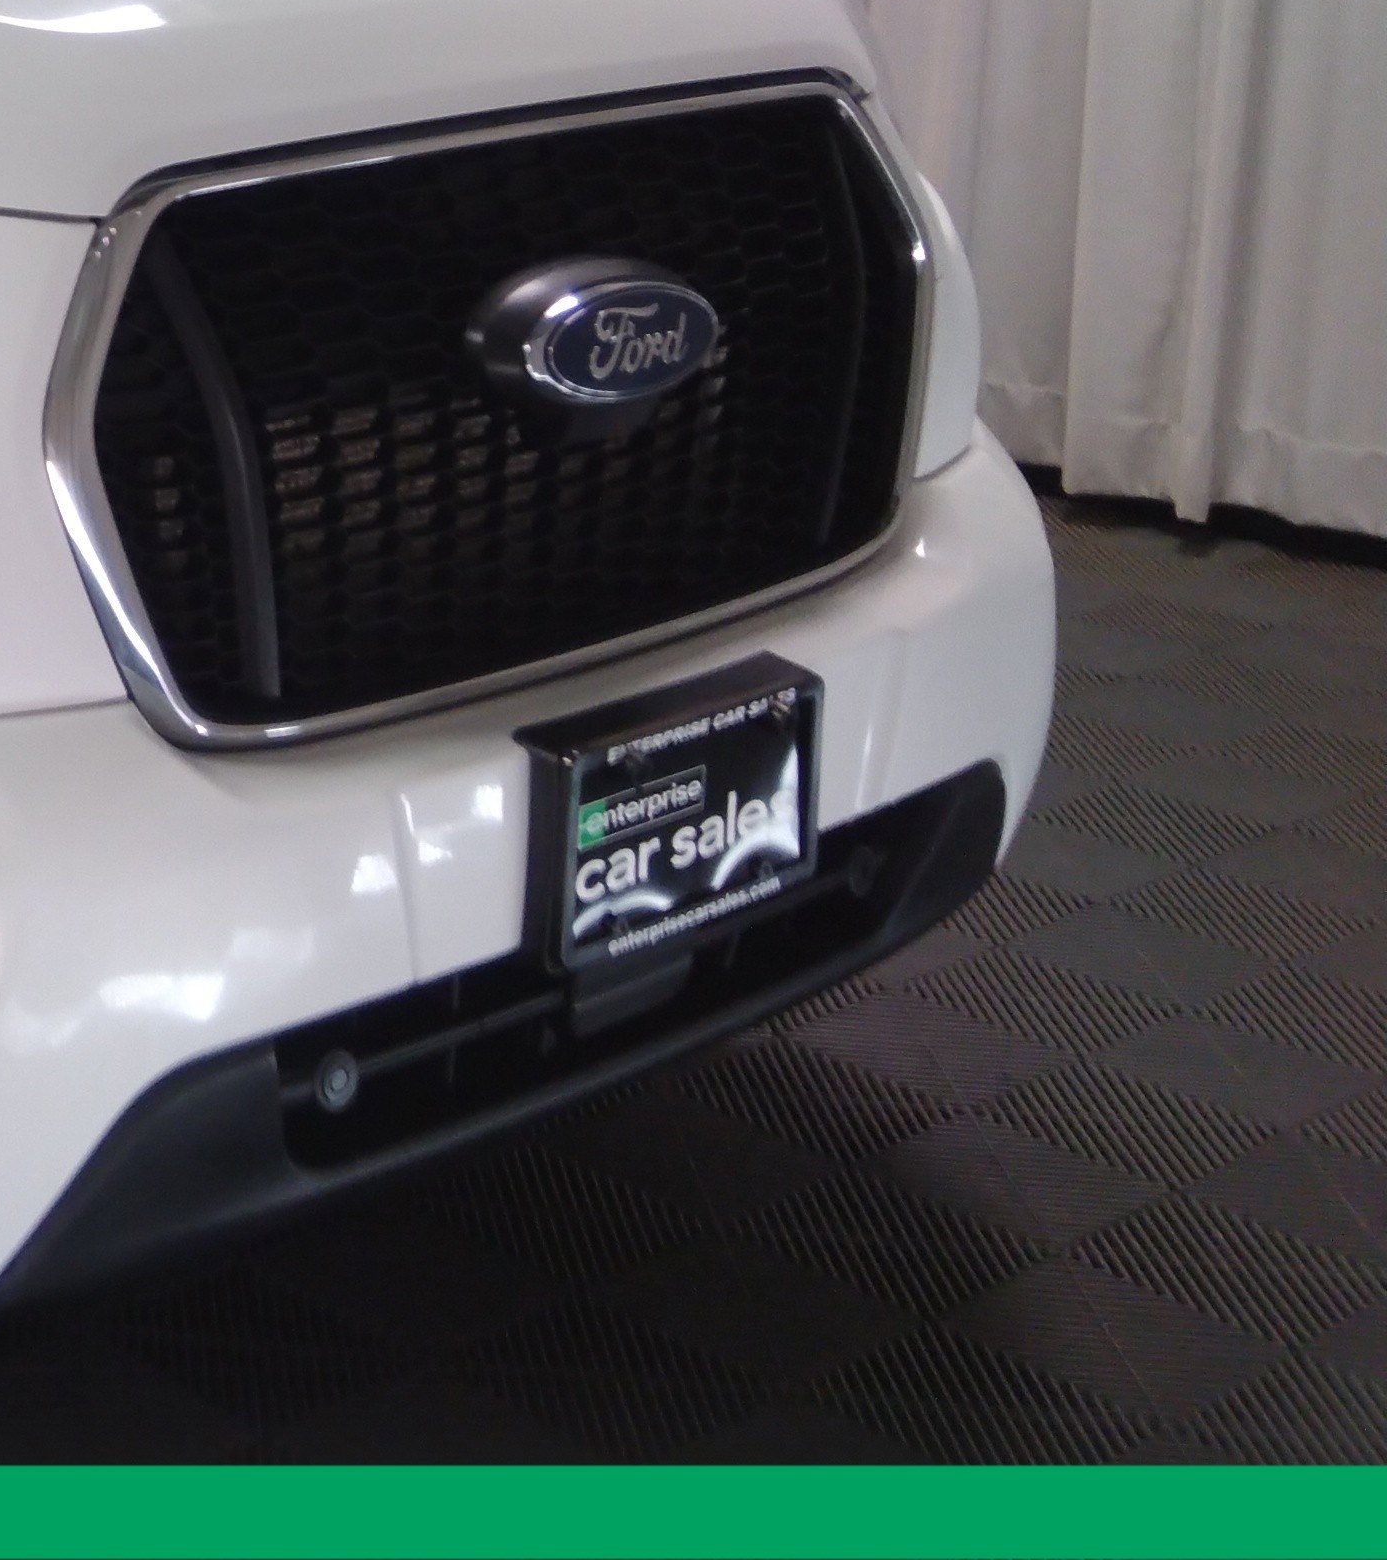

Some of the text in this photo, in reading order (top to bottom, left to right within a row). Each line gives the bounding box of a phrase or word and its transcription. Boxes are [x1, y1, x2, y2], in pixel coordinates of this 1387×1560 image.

[589, 302, 689, 380] Ford
[583, 779, 704, 836] enterprise
[575, 836, 661, 904] car
